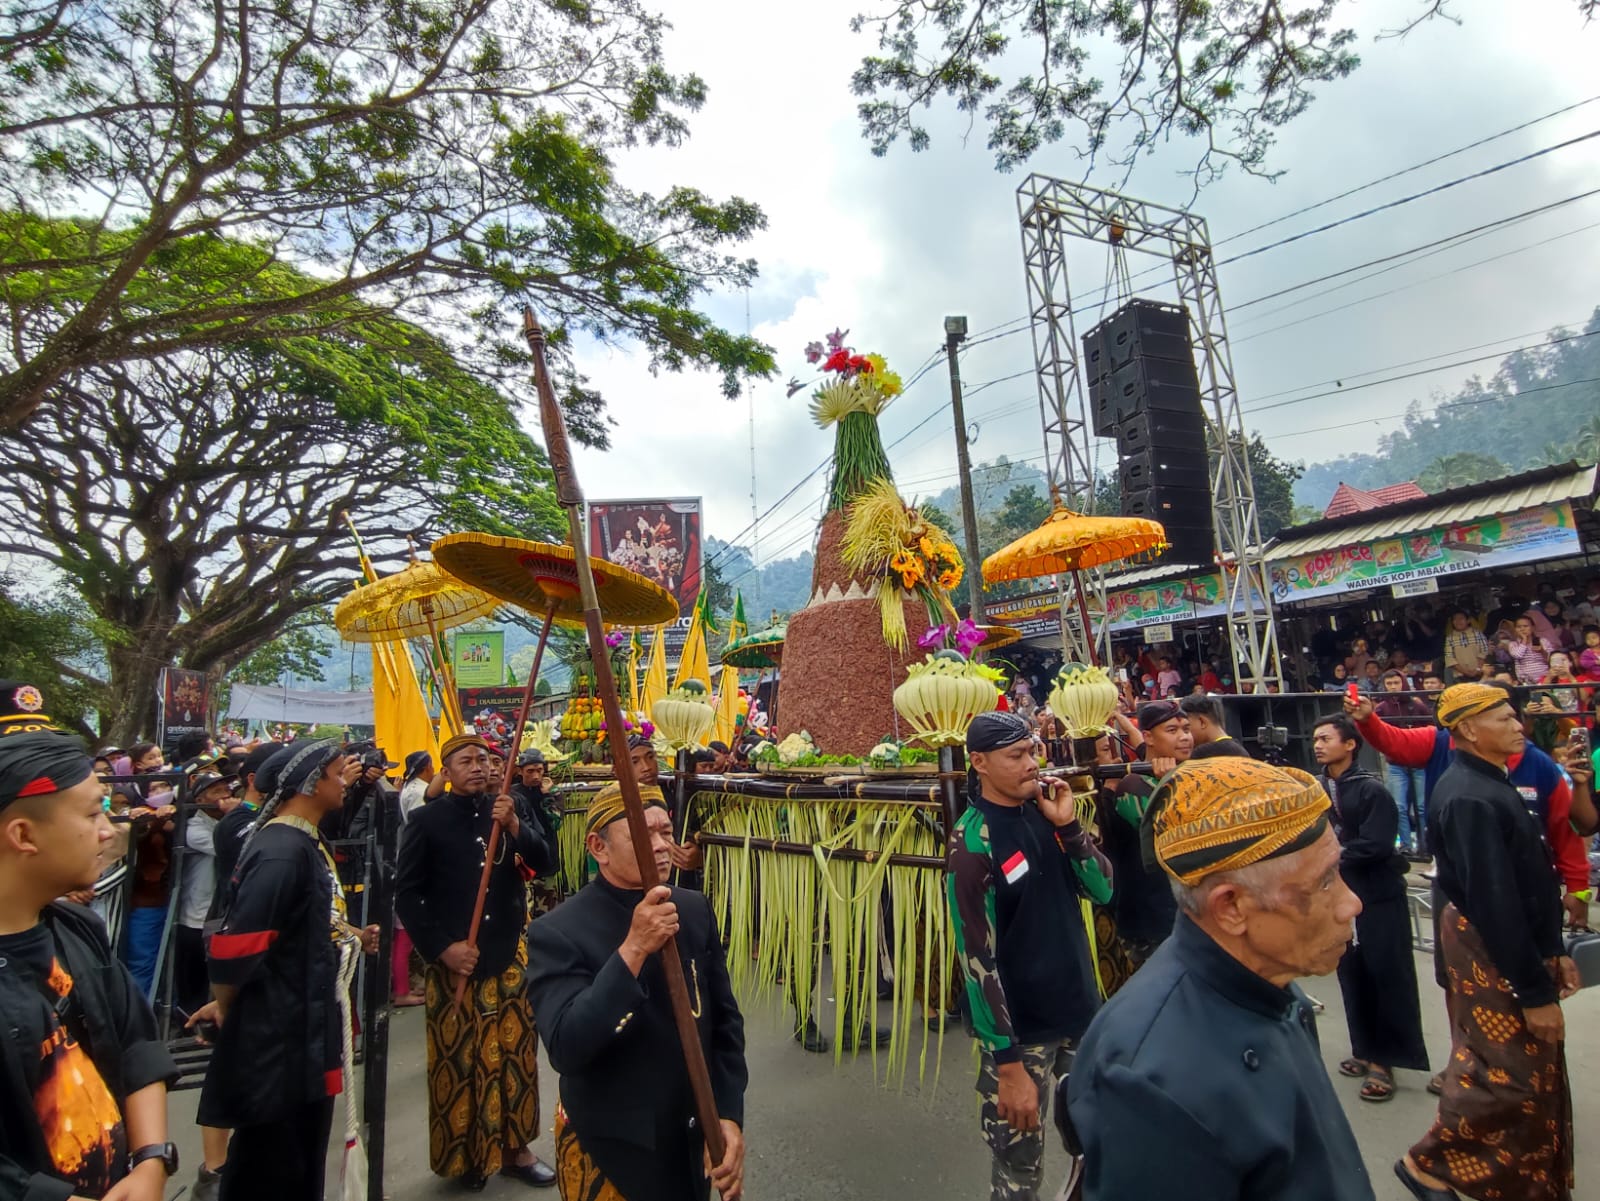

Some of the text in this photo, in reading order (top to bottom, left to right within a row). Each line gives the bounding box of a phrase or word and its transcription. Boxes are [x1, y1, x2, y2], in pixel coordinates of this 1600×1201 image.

[1346, 559, 1481, 589] WARUNG KOPI MBAK BELLA
[1136, 616, 1160, 626] WARUNG
